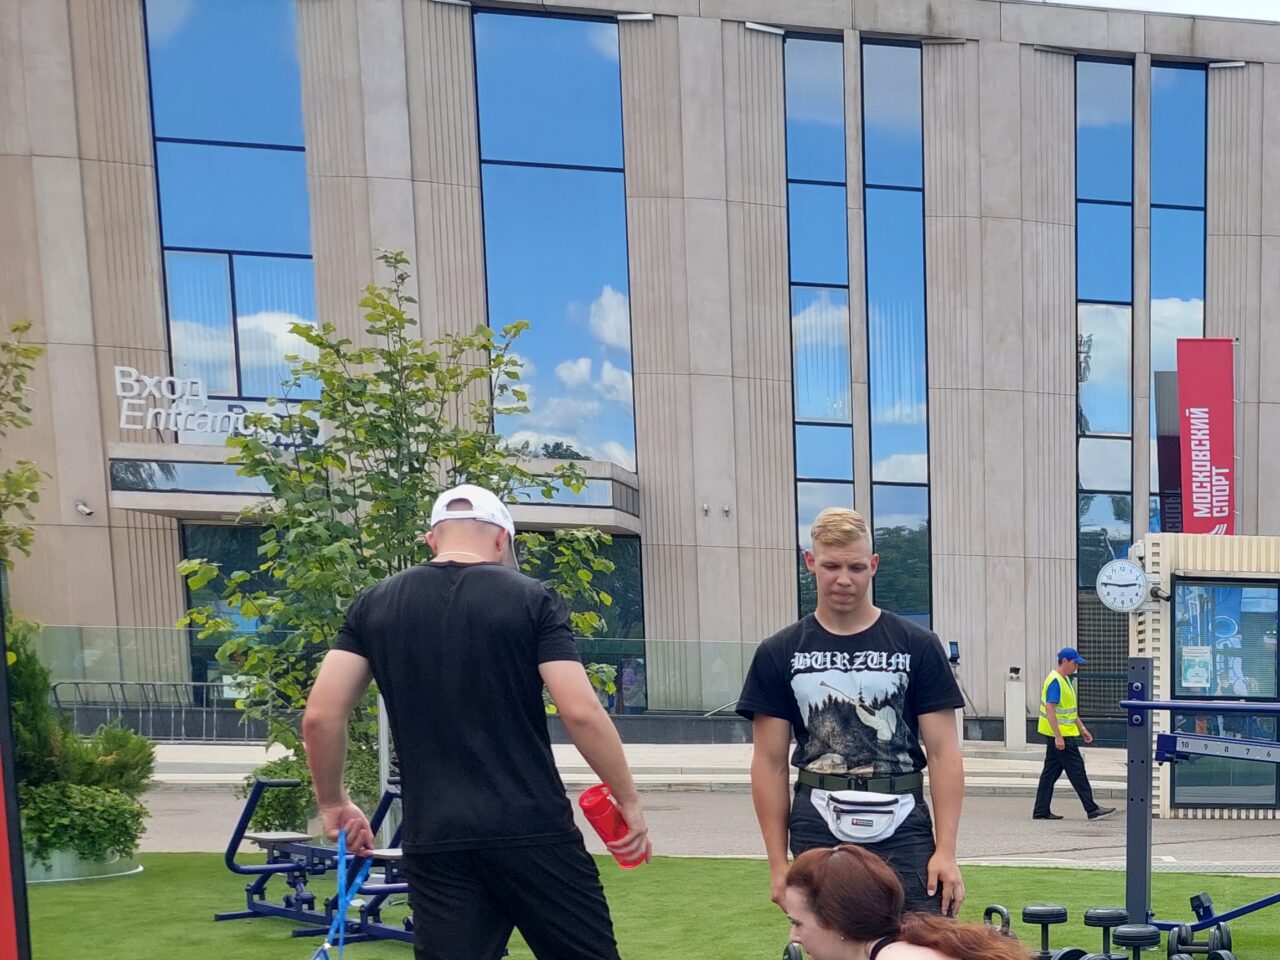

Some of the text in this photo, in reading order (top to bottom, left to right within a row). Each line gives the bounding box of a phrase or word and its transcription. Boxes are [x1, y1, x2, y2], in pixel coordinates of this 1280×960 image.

[114, 366, 206, 405] Вход
[1186, 407, 1212, 518] МОСКОВСКИЙ
[1212, 466, 1230, 518] СПОРТ
[791, 650, 911, 673] BURZUM
[1181, 741, 1189, 749] 10
